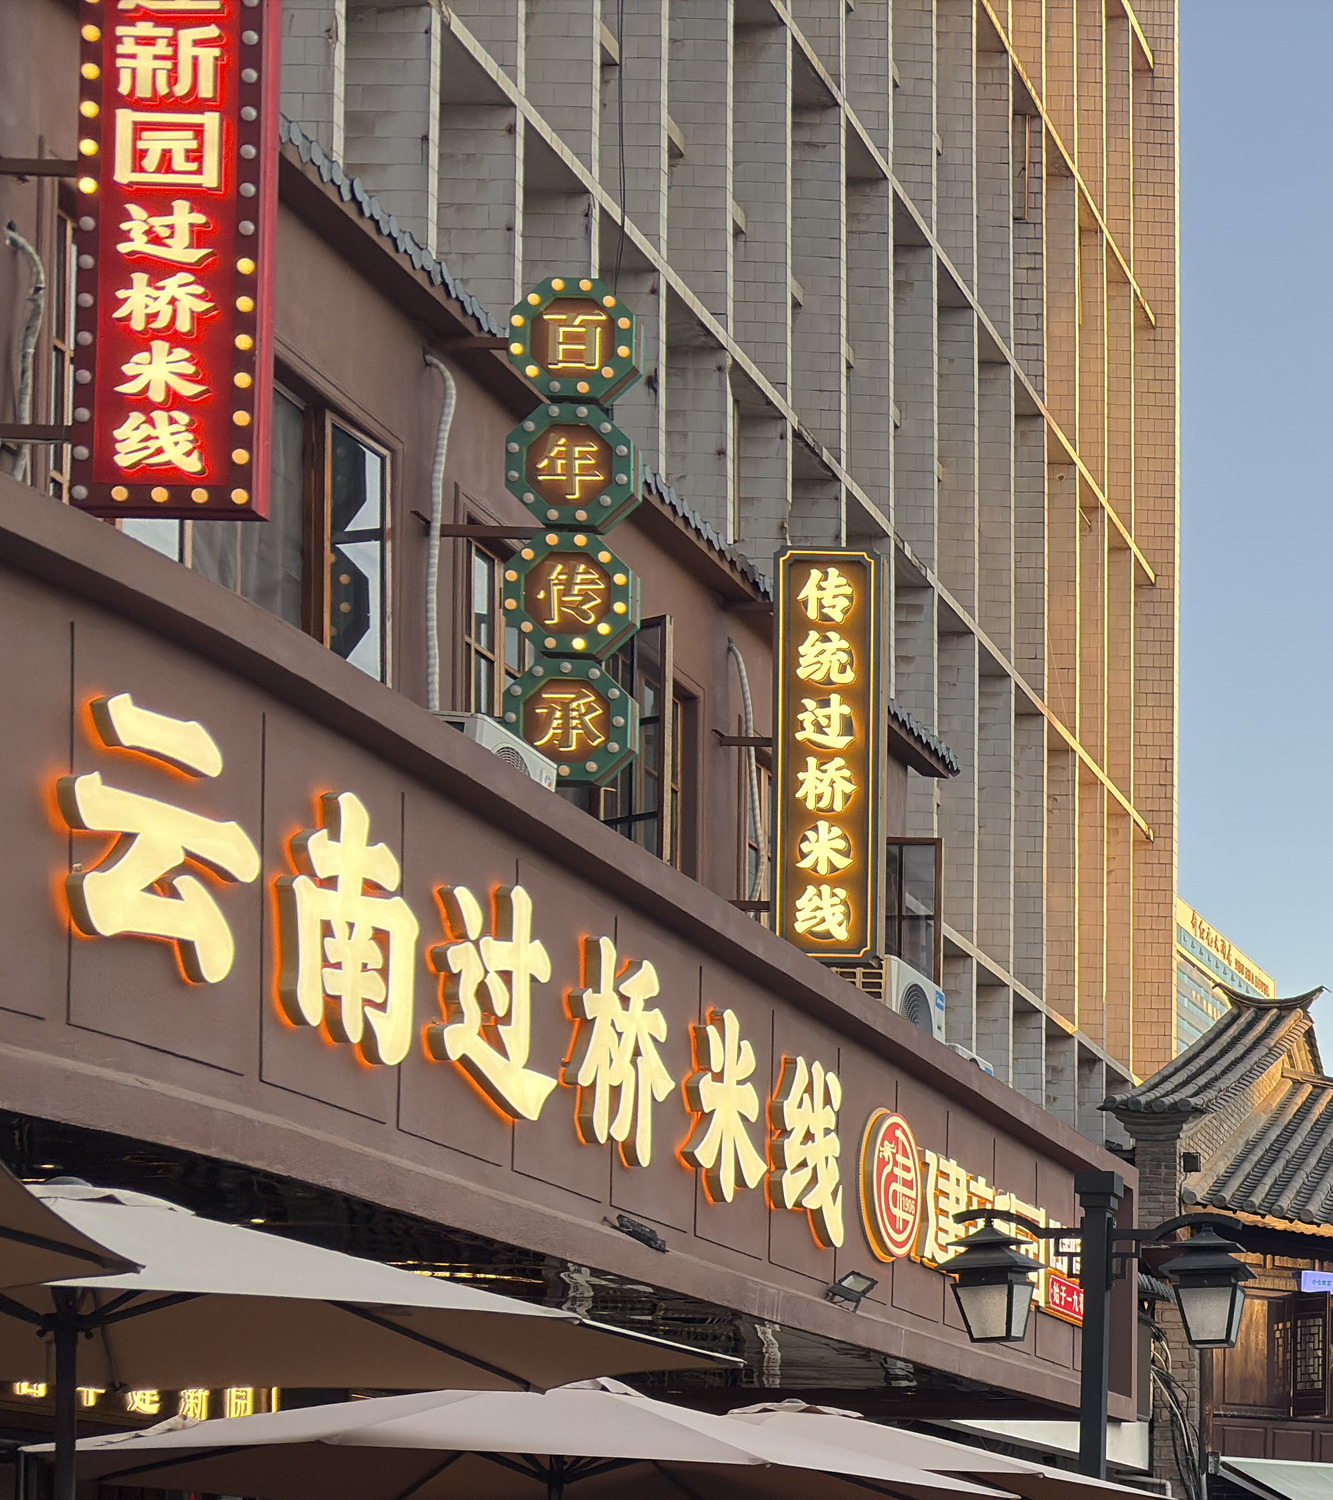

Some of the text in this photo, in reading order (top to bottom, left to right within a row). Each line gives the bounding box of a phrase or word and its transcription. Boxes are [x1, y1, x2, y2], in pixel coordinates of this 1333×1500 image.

[112, 0, 223, 475] 新园过桥米线
[535, 312, 608, 750] 百年传承
[796, 567, 858, 942] 传统过桥米线
[62, 692, 846, 1249] 云南过桥米线
